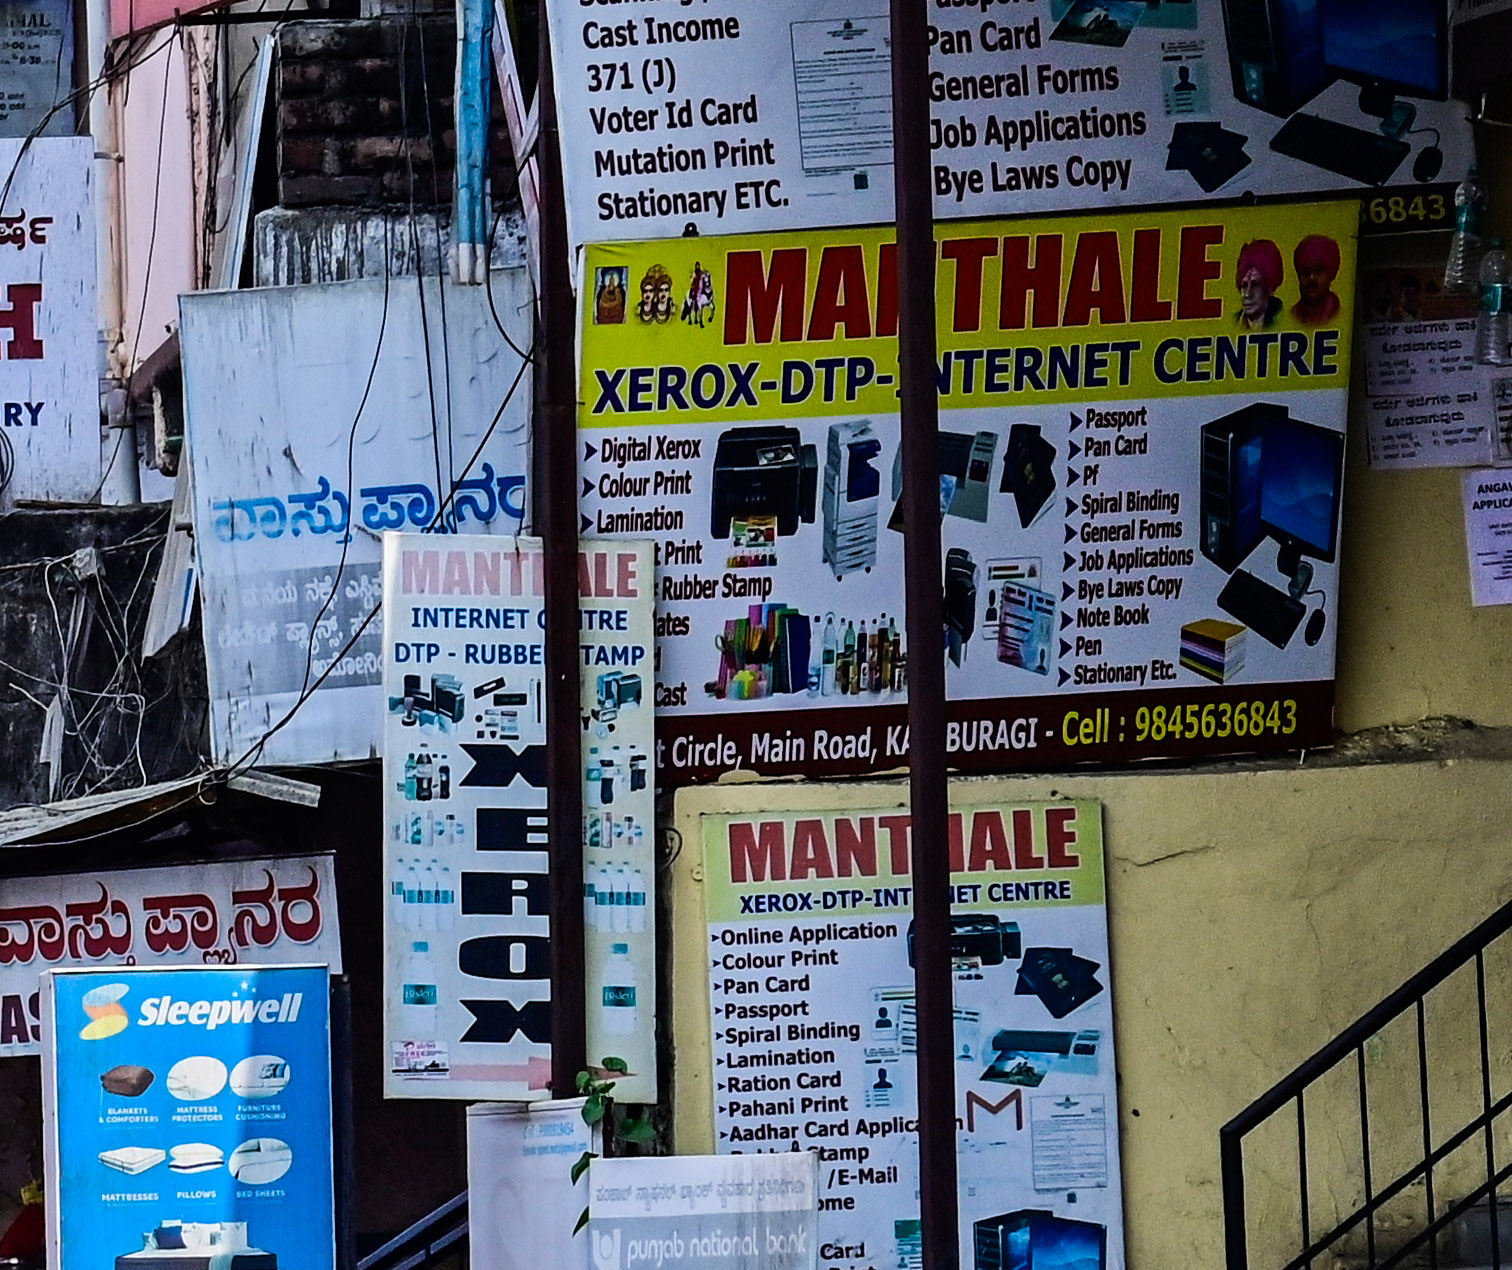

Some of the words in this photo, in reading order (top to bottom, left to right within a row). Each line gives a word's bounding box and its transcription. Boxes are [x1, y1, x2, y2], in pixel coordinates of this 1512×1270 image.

[583, 22, 638, 49] Cast
[645, 16, 740, 45] Income
[927, 25, 972, 56] Pan
[980, 18, 1041, 52] Card
[587, 62, 634, 93] 371
[642, 57, 676, 94] (J)
[928, 65, 1029, 102] General
[1037, 64, 1120, 95] Forms
[590, 106, 659, 135] Voter
[666, 99, 693, 129] Id
[701, 95, 758, 127] Card
[930, 116, 976, 150] Job
[985, 107, 1146, 152] Applications
[595, 143, 706, 177] Mutation
[714, 138, 776, 168] Print
[934, 165, 983, 201] Bye
[991, 161, 1059, 193] Laws
[1066, 155, 1132, 192] Copy
[598, 187, 728, 221] Stationary
[735, 179, 790, 210] ETC.
[1153, 329, 1340, 384] CENTRE
[1085, 406, 1147, 431] Passport
[601, 437, 651, 468] Digital
[655, 437, 702, 461] Xerox
[1084, 437, 1112, 457] Pan
[1114, 433, 1148, 455] Card
[599, 471, 651, 498] Colour
[654, 470, 692, 496] Print
[1082, 464, 1100, 486] Pf
[1081, 492, 1122, 518] Spiral
[1126, 490, 1180, 515] Binding
[597, 505, 683, 534] Lamination
[1080, 519, 1135, 543] General
[1139, 518, 1183, 540] Forms
[665, 539, 703, 565] Print
[1078, 551, 1104, 573] Job
[1107, 546, 1194, 573] Applications
[662, 576, 718, 601] Rubber
[722, 573, 773, 602] Stamp
[1078, 578, 1104, 604] Bye
[1108, 577, 1145, 598] Laws
[1147, 575, 1183, 600] Copy
[412, 606, 530, 630] INTERNET
[1076, 608, 1111, 628] Note
[1114, 603, 1150, 626] Book
[395, 643, 440, 664] DTP
[1075, 635, 1102, 657] Pen
[1073, 663, 1147, 686] Stationary
[1151, 660, 1177, 681] Etc.
[672, 733, 744, 771] Circle,
[750, 729, 805, 764] Main
[813, 726, 878, 764] Road,
[1062, 707, 1110, 746] Cell
[1135, 699, 1298, 742] 9845636843
[988, 880, 1071, 903] CENTRE
[721, 927, 783, 947] Online
[789, 922, 898, 946] Application
[722, 952, 785, 970] Colour
[791, 949, 839, 967] Print
[724, 979, 759, 995] Pan
[765, 974, 810, 992] Card
[137, 992, 303, 1031] Sleepwell
[724, 1000, 809, 1021] Passport
[725, 1025, 781, 1047] Spiral
[787, 1022, 860, 1042] Binding
[726, 1048, 835, 1069] Lamination
[727, 1075, 791, 1093] Ration
[796, 1070, 841, 1089] Card
[729, 1099, 794, 1117] Pahani
[801, 1096, 849, 1113] Print
[729, 1123, 799, 1142] Aadhar
[804, 1119, 849, 1138] Card
[176, 1190, 217, 1200] PILLOWS
[627, 1230, 684, 1269] punjab
[690, 1229, 759, 1257] national
[766, 1226, 808, 1255] bank
[820, 1242, 865, 1260] Card
